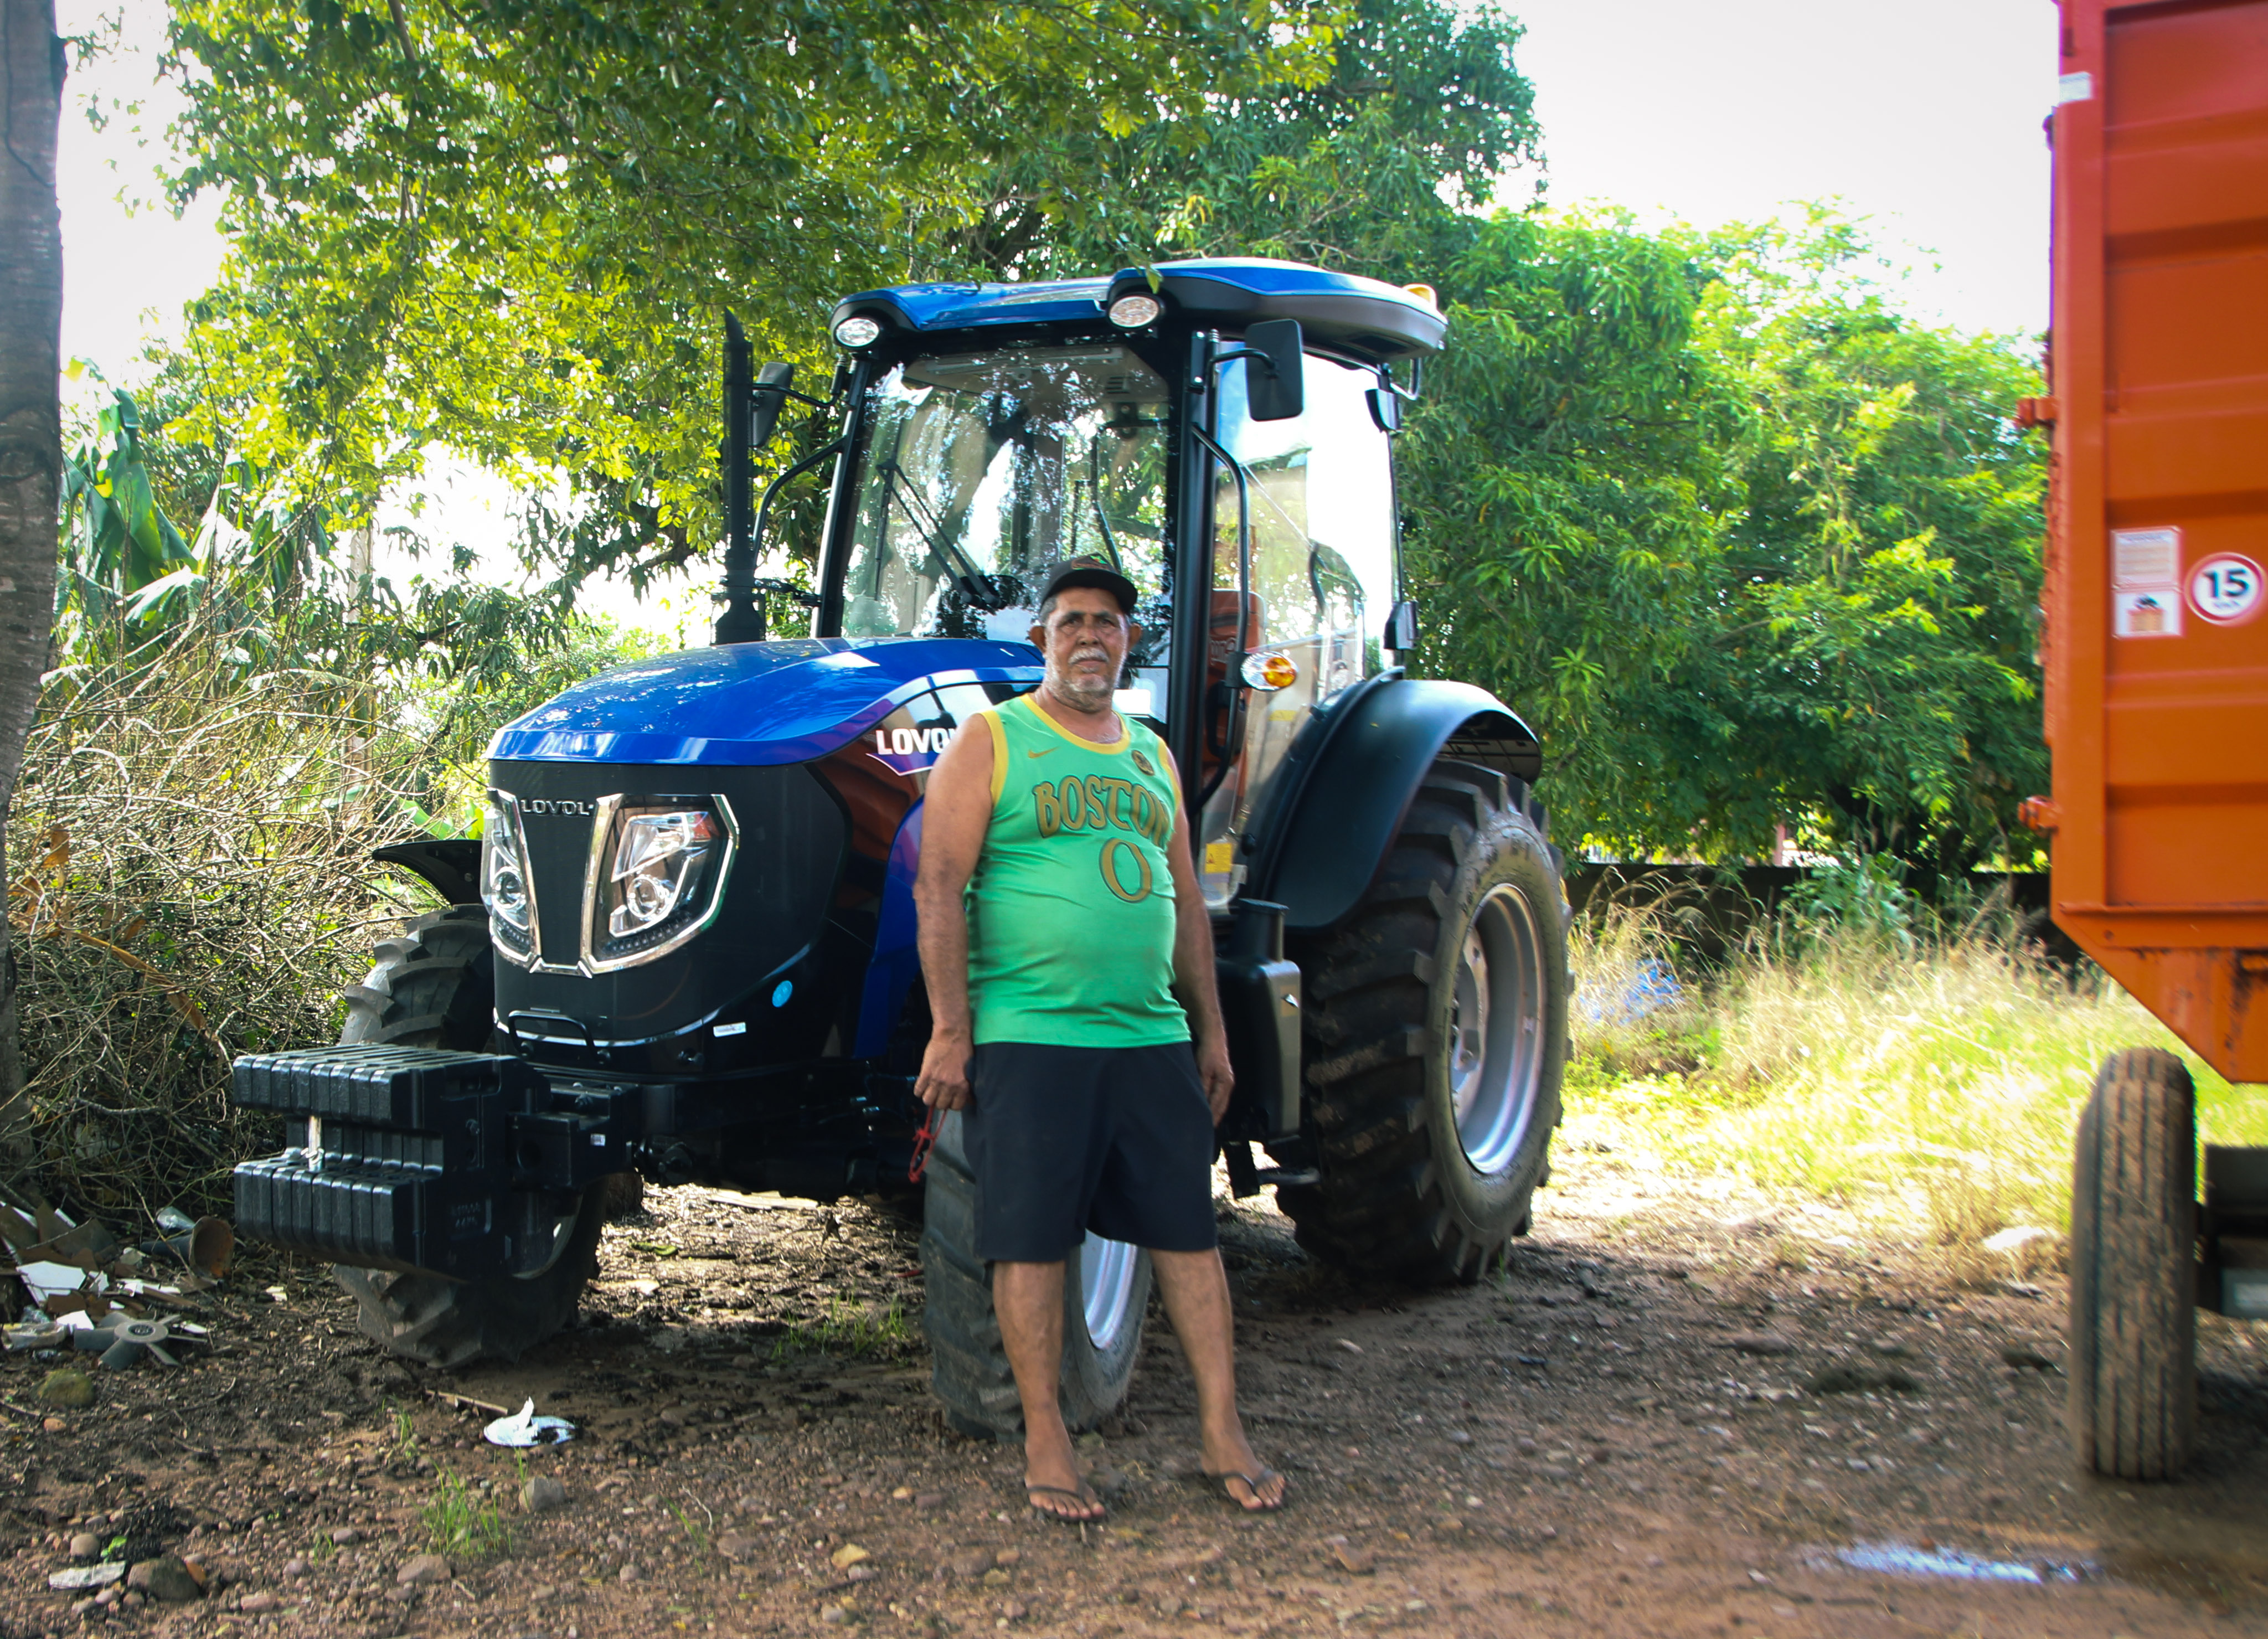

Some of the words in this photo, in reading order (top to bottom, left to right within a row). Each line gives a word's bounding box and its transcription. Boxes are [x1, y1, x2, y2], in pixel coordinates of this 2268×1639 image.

[2202, 567, 2249, 598] 15
[875, 728, 957, 755] LOVO
[520, 799, 590, 816] LOVOL
